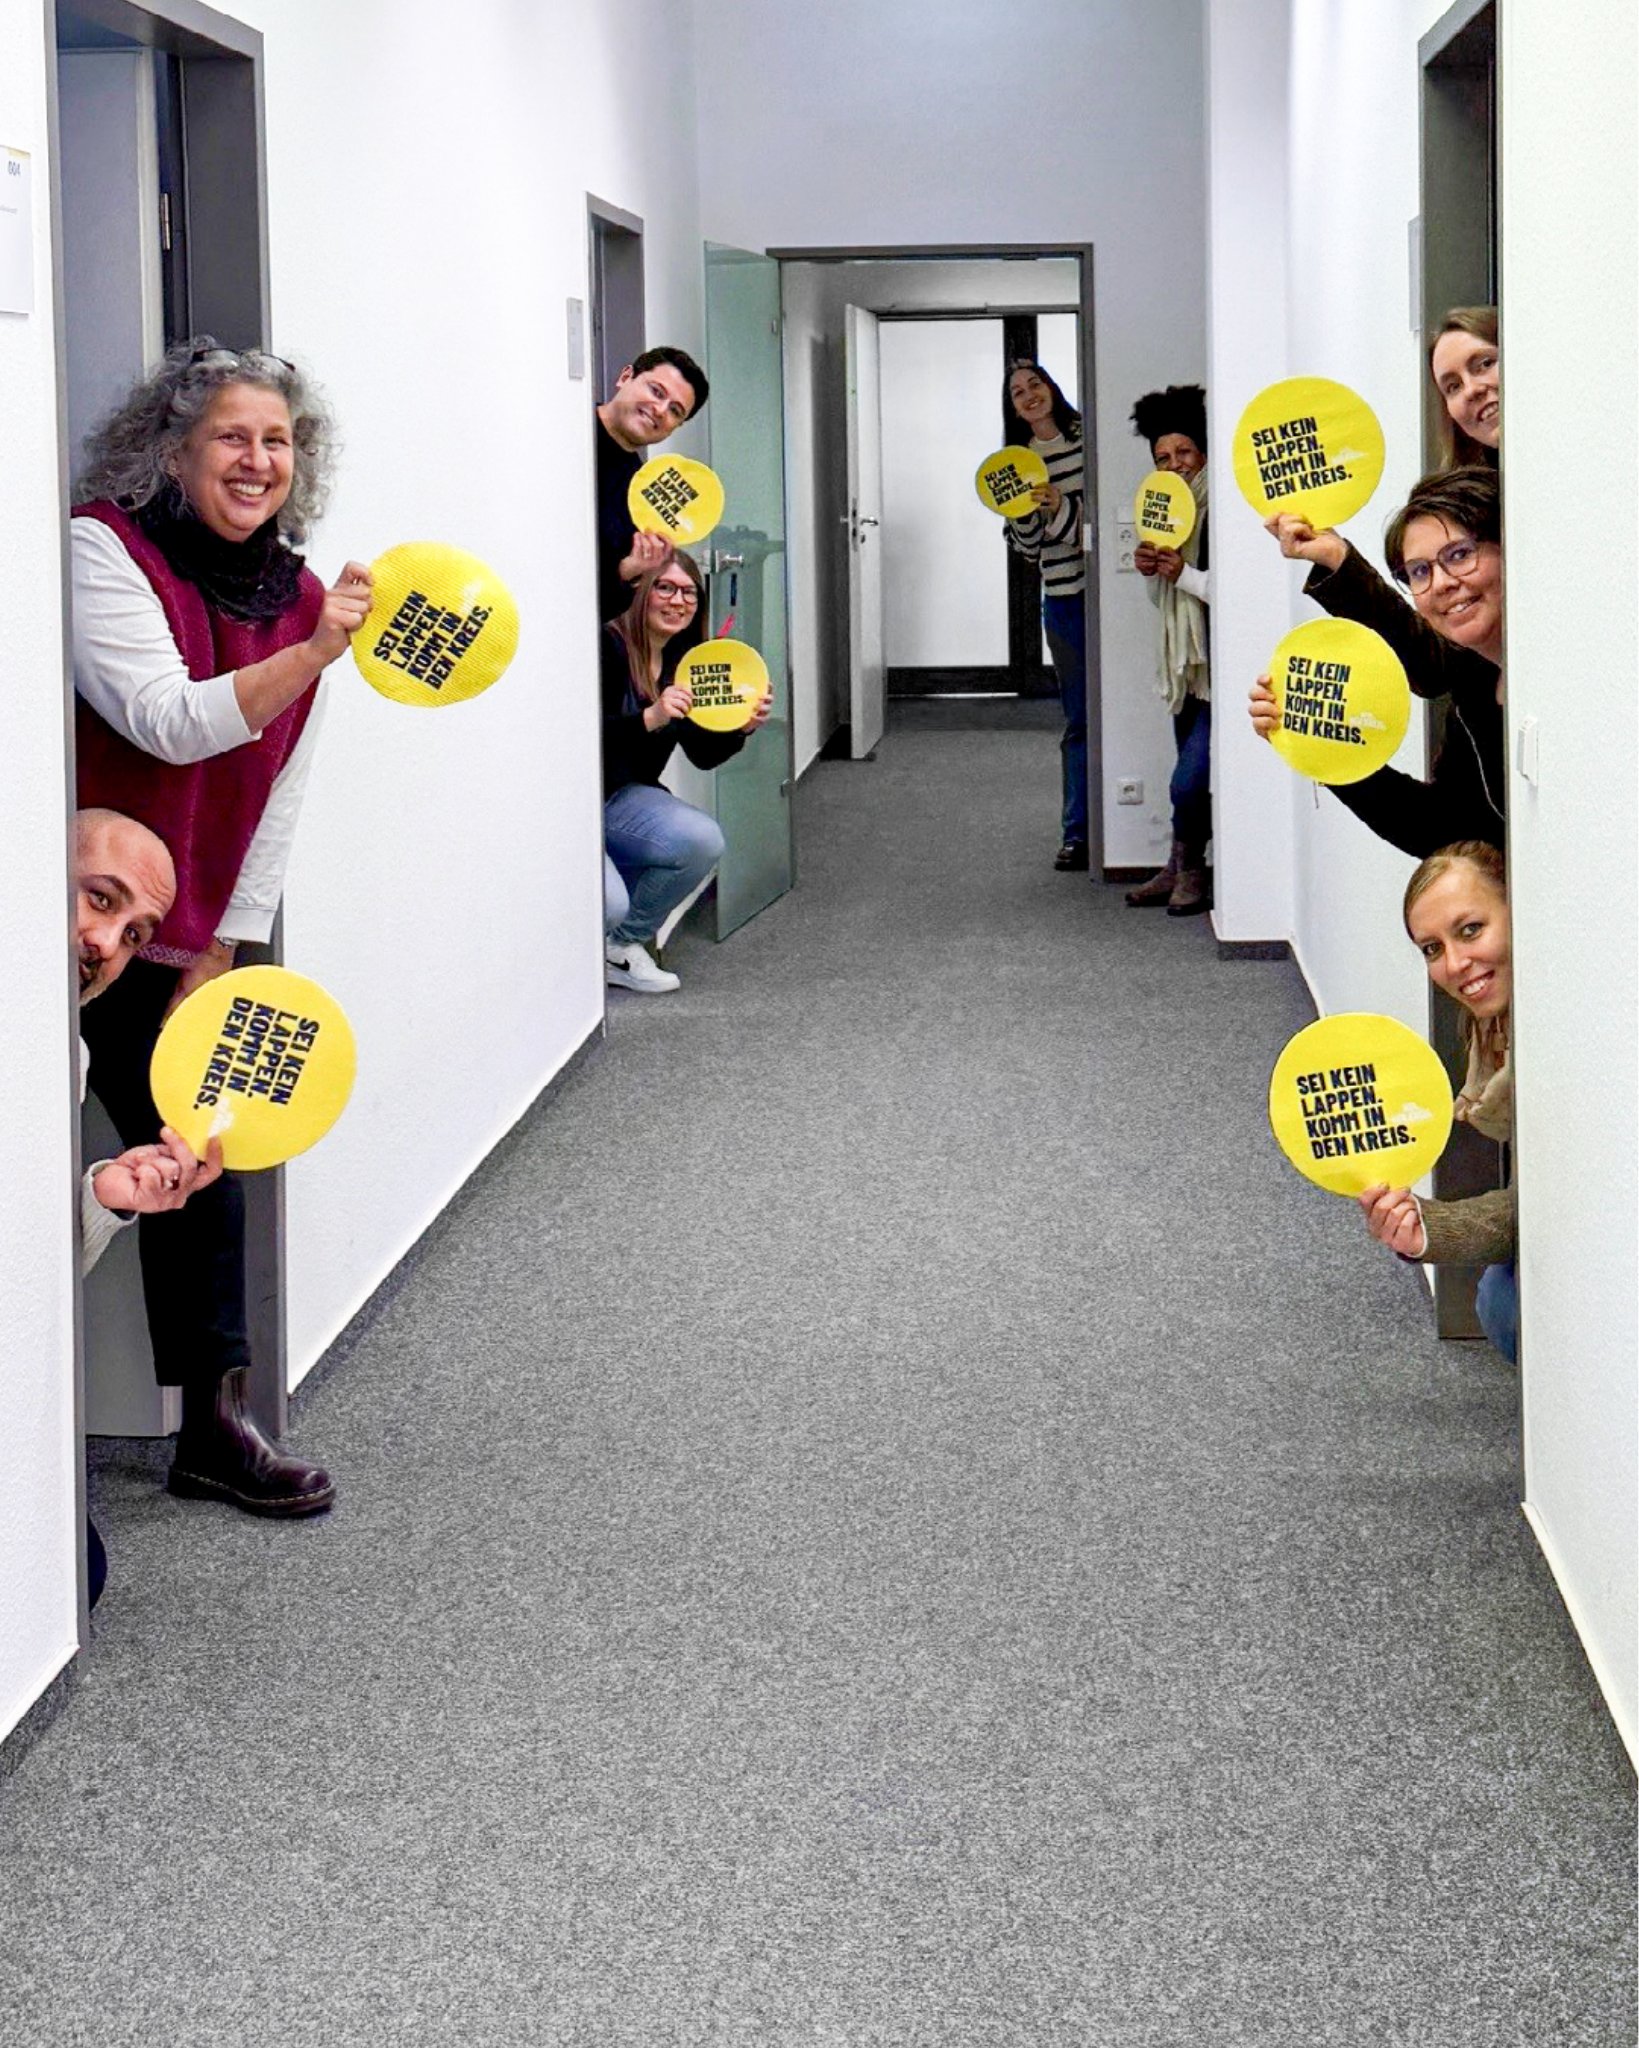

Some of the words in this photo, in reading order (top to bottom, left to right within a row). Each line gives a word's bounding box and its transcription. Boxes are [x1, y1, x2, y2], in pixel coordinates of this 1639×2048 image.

[1252, 427, 1276, 447] SEI
[1279, 417, 1317, 440] KEIN
[1256, 435, 1323, 465] LAPPEN.
[1260, 457, 1306, 482] KOMM
[1309, 452, 1326, 469] IN
[1264, 478, 1296, 500] DEN
[1300, 465, 1352, 490] KREIS.
[374, 631, 400, 661] SEI
[390, 590, 428, 633] KEIN
[390, 604, 446, 669] LAPPEN.
[407, 631, 448, 680] KOMM
[439, 612, 462, 634] IN
[425, 655, 455, 689] DEN
[447, 606, 493, 659] KREIS.
[1289, 656, 1312, 675] SEI
[1314, 661, 1351, 682] KEIN
[1286, 675, 1347, 702] LAPPEN.
[1285, 694, 1324, 717] KOMM
[1328, 702, 1344, 721] IN
[1284, 713, 1309, 735] DEN
[1313, 719, 1366, 745] KREIS.
[222, 997, 253, 1040] DEN
[237, 1004, 276, 1066] KOMM
[290, 1017, 320, 1053] SEI
[248, 1011, 298, 1097] LAPPEN.
[193, 1043, 236, 1110] KREIS.
[227, 1068, 251, 1092] IN
[270, 1054, 305, 1105] KEIN
[1297, 1072, 1326, 1095] SEI
[1330, 1063, 1376, 1089] KEIN
[1301, 1086, 1383, 1117] LAPPEN.
[1305, 1111, 1360, 1138] KOMM
[1364, 1106, 1385, 1126] IN
[1311, 1136, 1348, 1159] DEN
[1352, 1125, 1416, 1154] KREIS.
